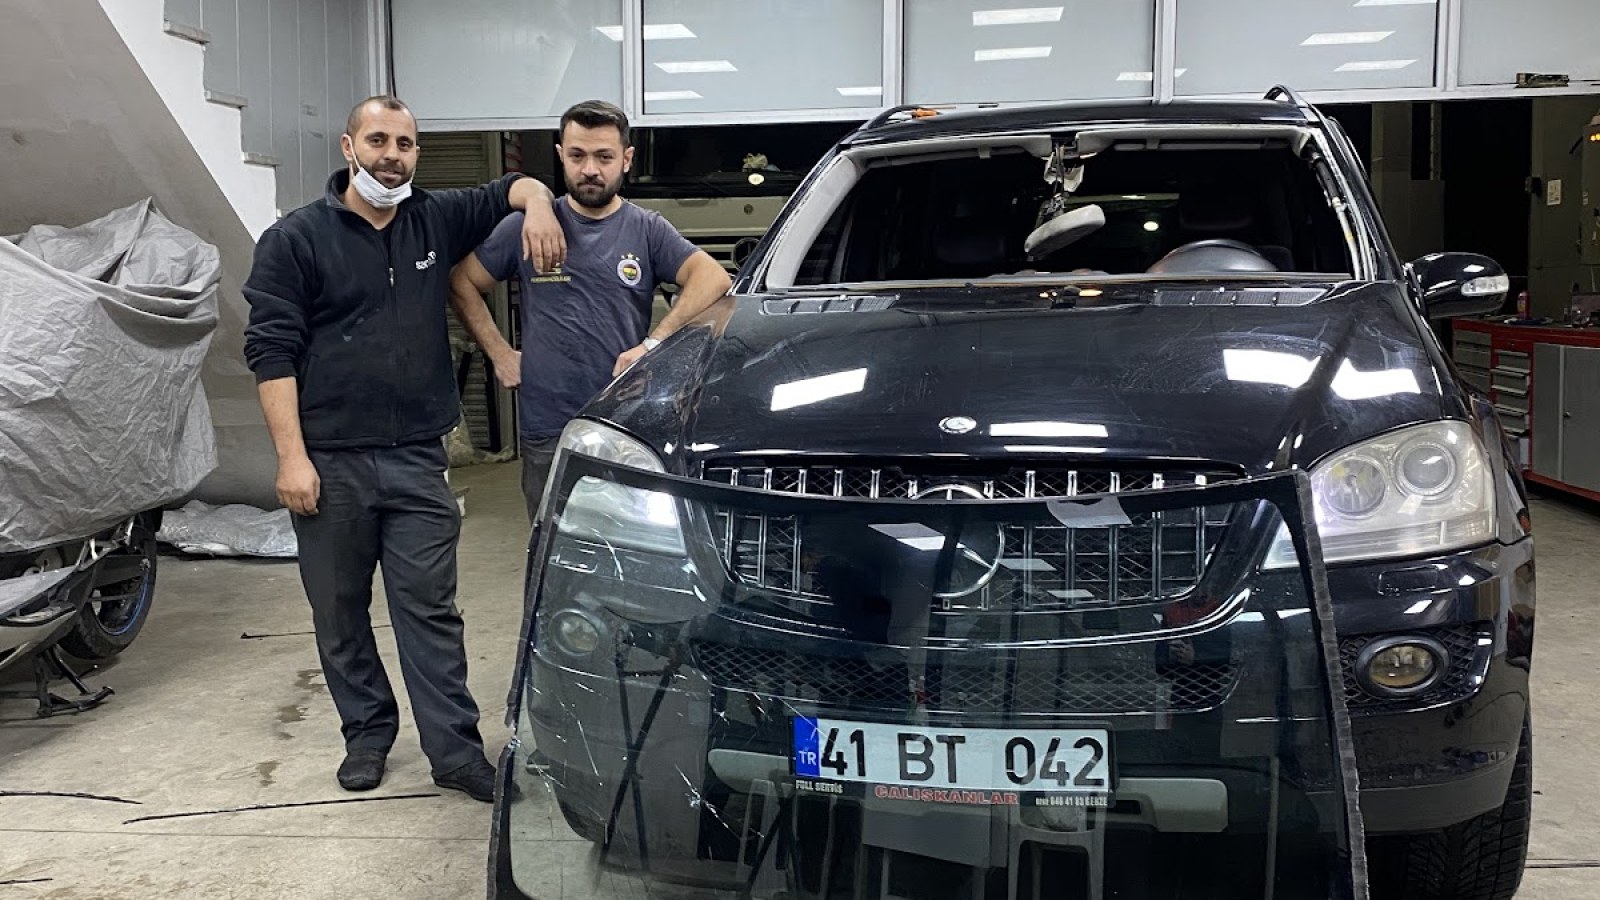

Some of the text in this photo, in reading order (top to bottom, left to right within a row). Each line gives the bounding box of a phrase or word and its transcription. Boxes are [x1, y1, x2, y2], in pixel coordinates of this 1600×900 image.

[798, 750, 817, 766] TR
[821, 727, 1105, 787] 41 BT 042
